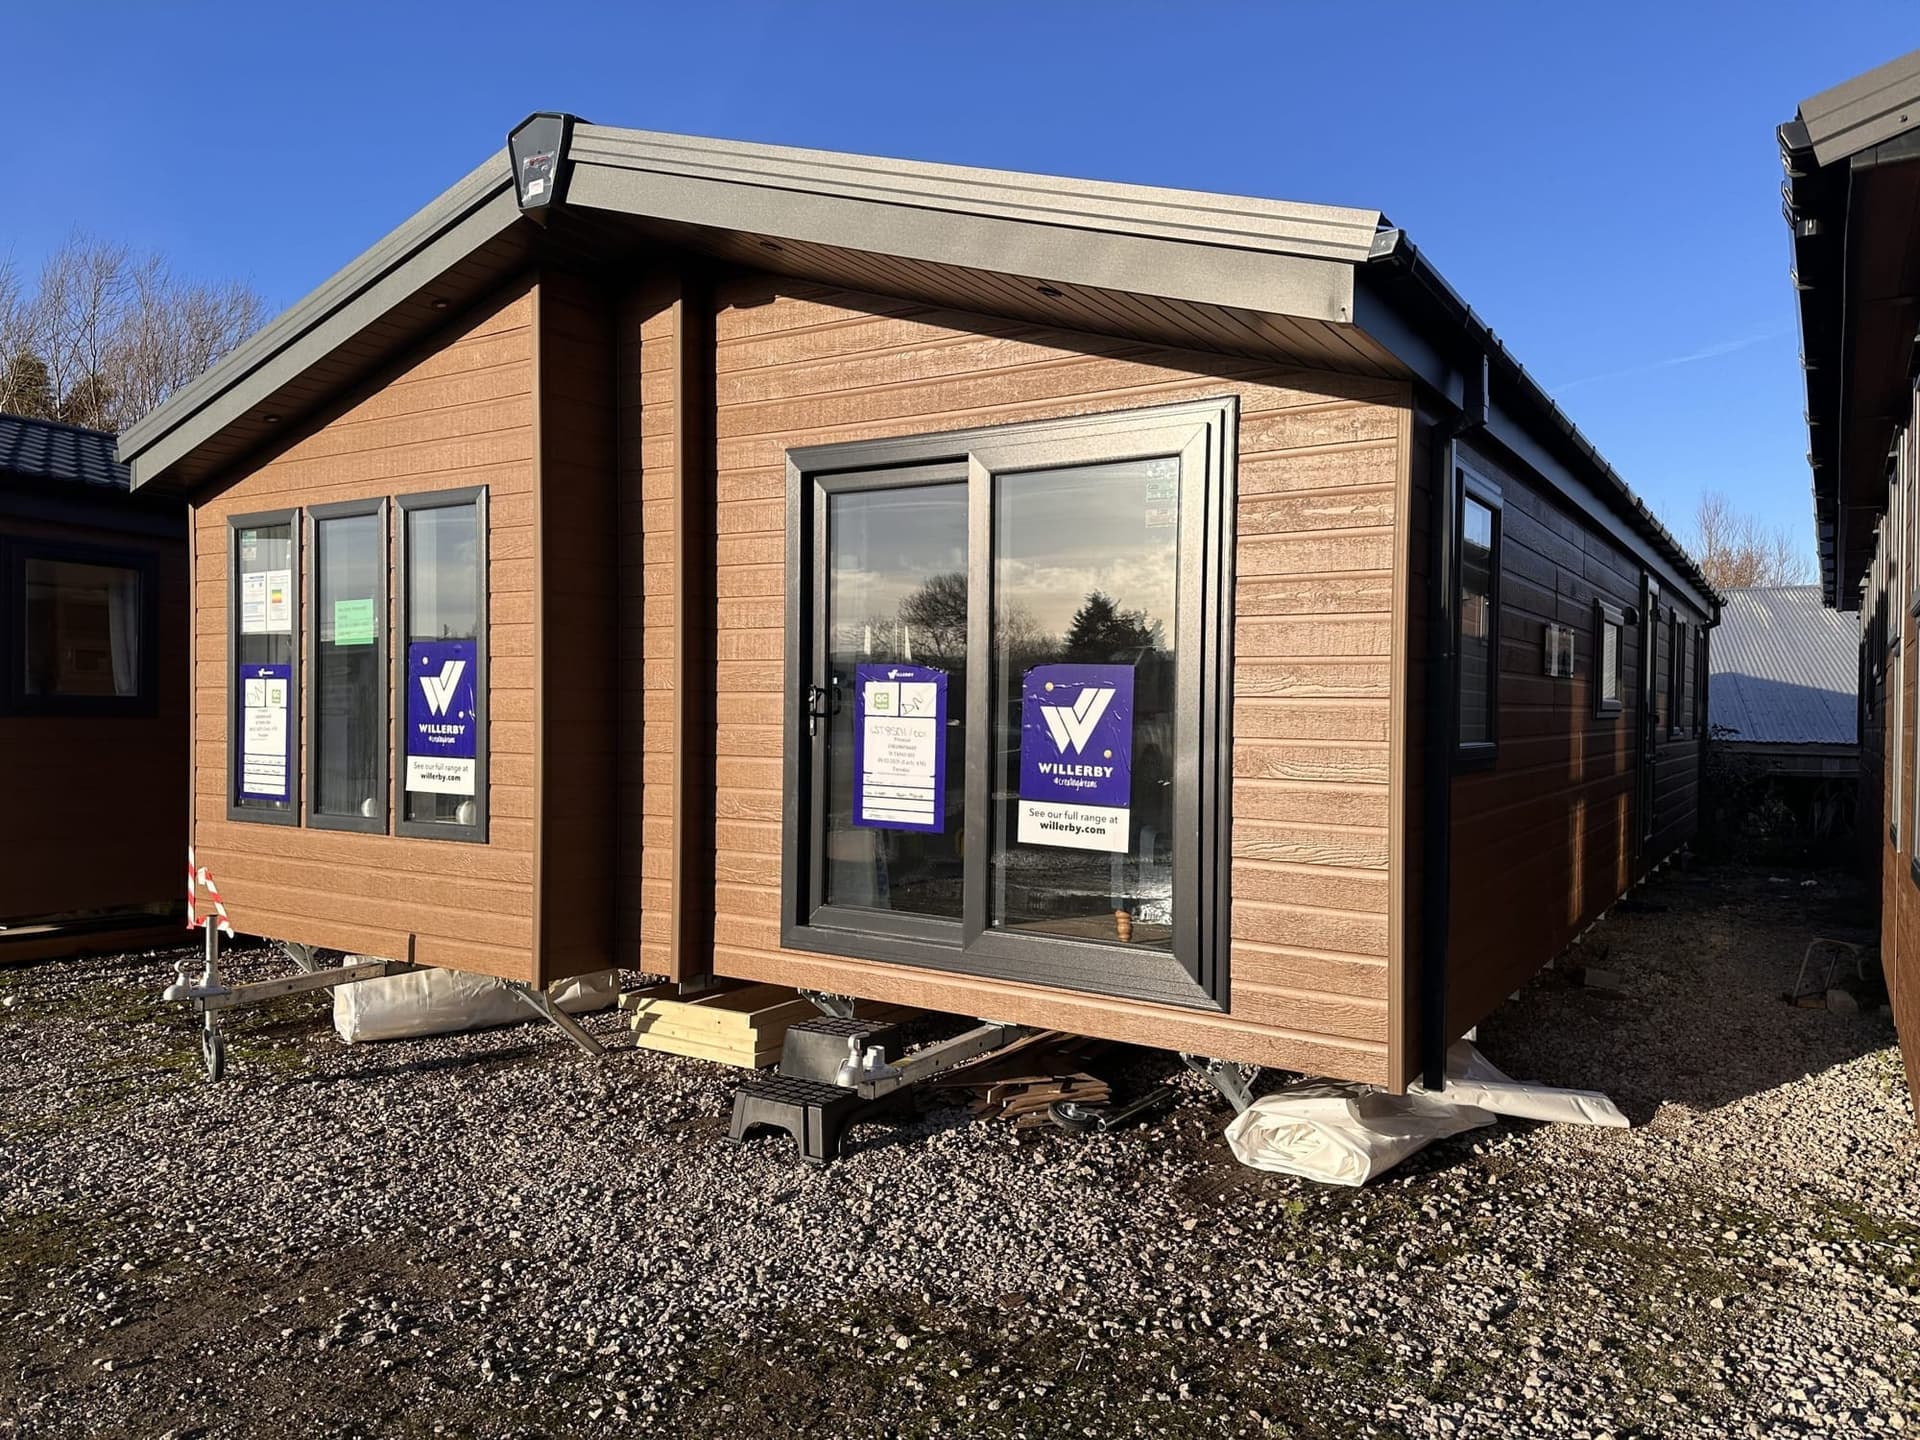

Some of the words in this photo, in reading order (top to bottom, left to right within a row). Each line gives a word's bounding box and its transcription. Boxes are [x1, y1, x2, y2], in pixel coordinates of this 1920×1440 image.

[418, 723, 466, 735] WILLERBY
[413, 762, 424, 770] See
[435, 762, 445, 770] full
[445, 765, 461, 774] range
[1037, 762, 1114, 778] WILLERBY
[420, 772, 461, 783] willerby.com
[1028, 808, 1046, 818] See
[1047, 810, 1062, 819] our
[1064, 810, 1079, 821] full
[1080, 813, 1107, 824] range
[1109, 816, 1119, 824] at
[1039, 820, 1106, 835] willerby.com
